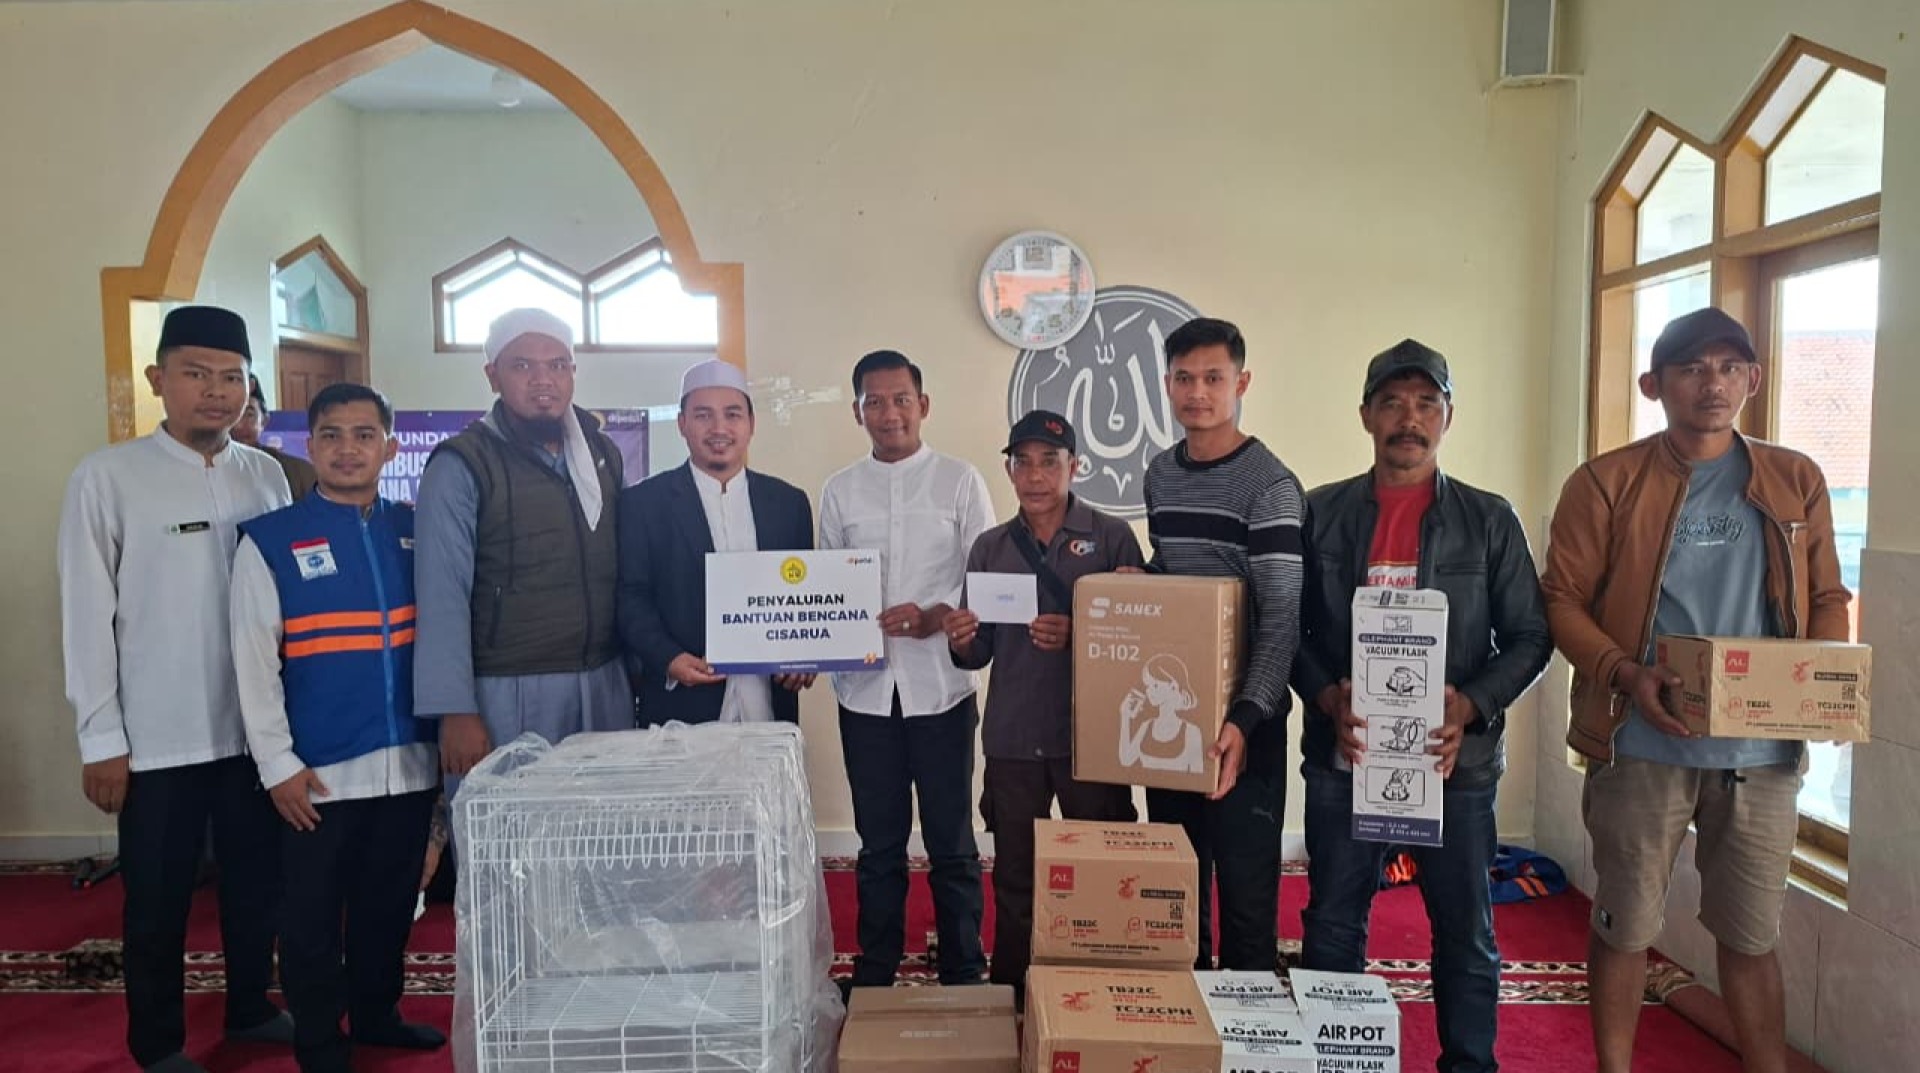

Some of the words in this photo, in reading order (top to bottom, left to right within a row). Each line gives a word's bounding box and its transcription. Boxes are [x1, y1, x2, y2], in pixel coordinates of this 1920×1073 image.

[747, 593, 844, 607] PENYALURAN
[1115, 602, 1162, 617] SANEX
[722, 611, 794, 624] BANTUAN
[797, 609, 869, 622] BENCANA
[766, 627, 831, 640] CISARUA
[1088, 643, 1140, 661] D-102
[1365, 646, 1399, 656] VACUUM
[1402, 647, 1429, 657] FLASK
[1105, 985, 1156, 993] TB22C
[1113, 1004, 1192, 1015] TC22CPH
[1318, 1023, 1346, 1040] AIR
[1349, 1025, 1387, 1041] POT
[1055, 1059, 1077, 1069] AL
[1318, 1058, 1354, 1069] VACUUM
[1356, 1060, 1384, 1070] FLASK
